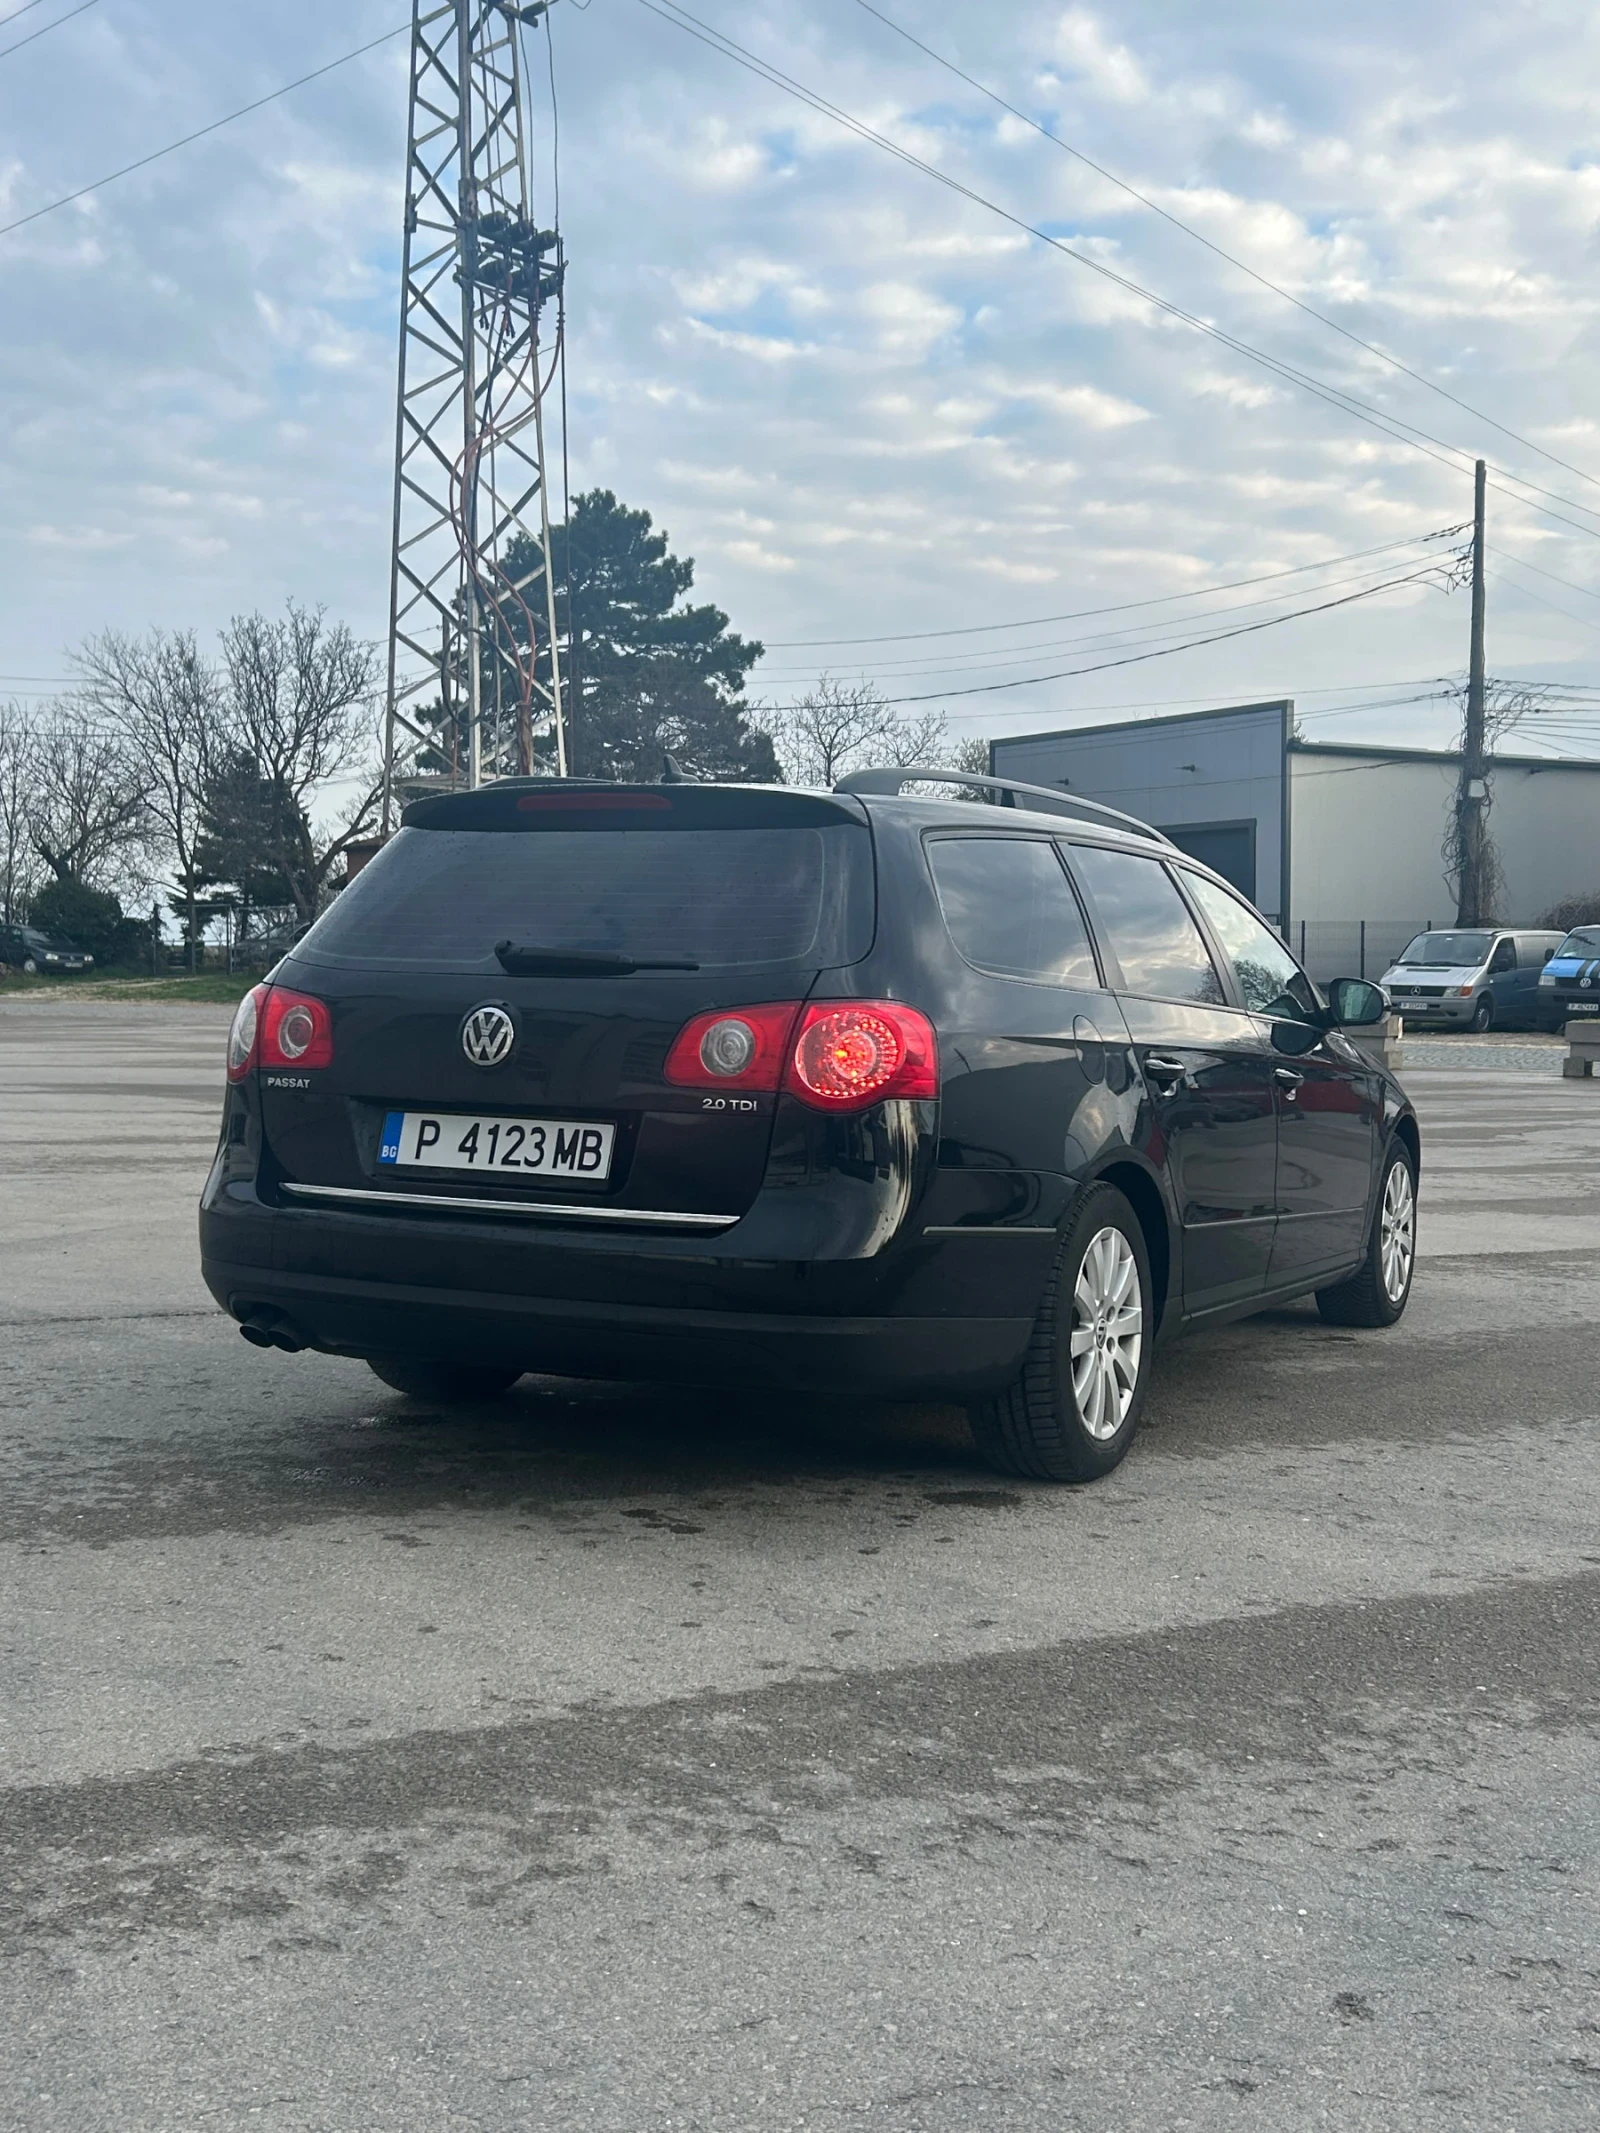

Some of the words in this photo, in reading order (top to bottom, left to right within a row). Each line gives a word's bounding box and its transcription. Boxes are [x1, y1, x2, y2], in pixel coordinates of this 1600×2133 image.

[463, 1007, 514, 1066] VW
[267, 1077, 311, 1089] PASSAT
[729, 1099, 758, 1111] TDI
[414, 1119, 441, 1160] P
[381, 1145, 397, 1158] BG
